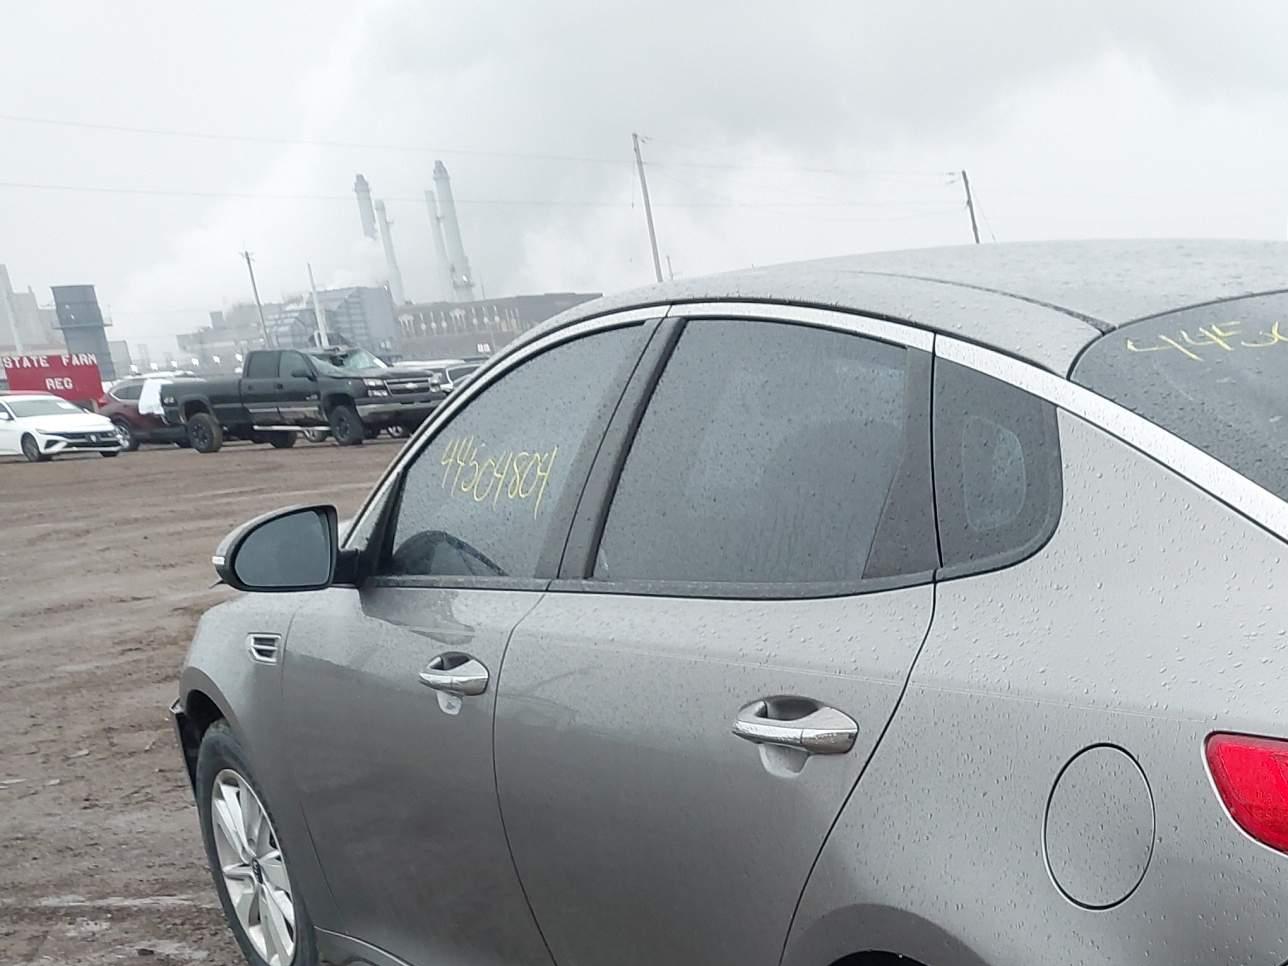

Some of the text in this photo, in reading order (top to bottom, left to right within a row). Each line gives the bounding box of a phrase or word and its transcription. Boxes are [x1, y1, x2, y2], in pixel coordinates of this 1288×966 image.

[3, 354, 50, 368] STATE
[45, 377, 73, 390] REG
[440, 435, 558, 520] 44504804
